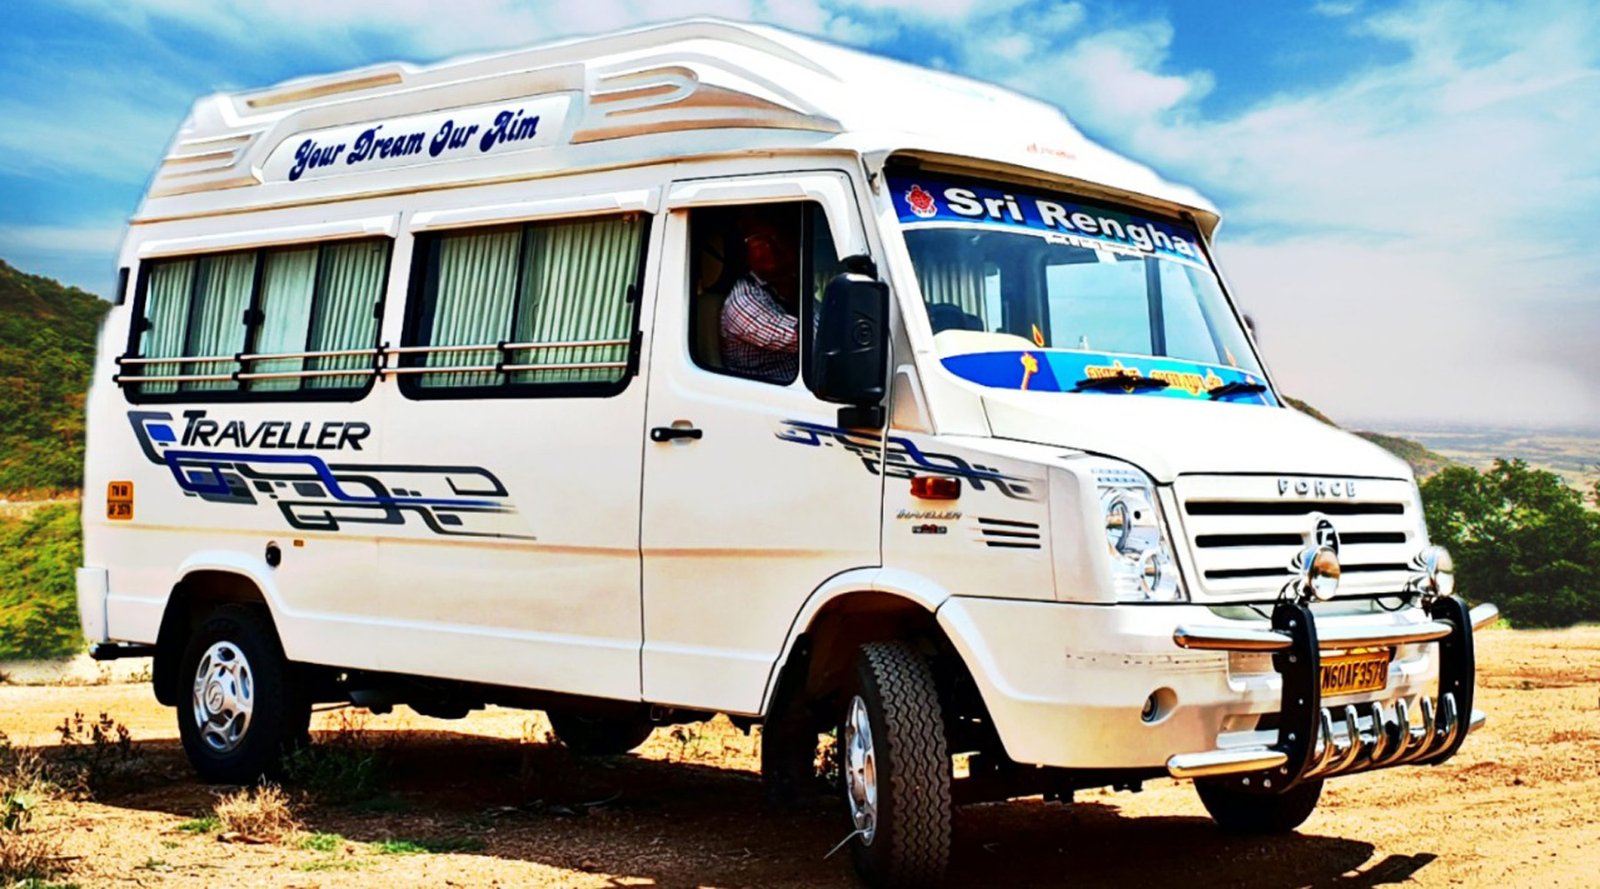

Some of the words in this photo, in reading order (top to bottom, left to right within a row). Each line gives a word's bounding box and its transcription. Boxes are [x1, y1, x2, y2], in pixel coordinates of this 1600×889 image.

[288, 139, 345, 182] Your
[346, 125, 425, 165] Dream
[429, 120, 479, 157] Our
[479, 109, 540, 152] Aim
[944, 187, 1025, 221] Sri
[1035, 200, 1195, 257] Rengha
[181, 410, 371, 450] TRAVELLER
[1277, 479, 1356, 498] FORCE
